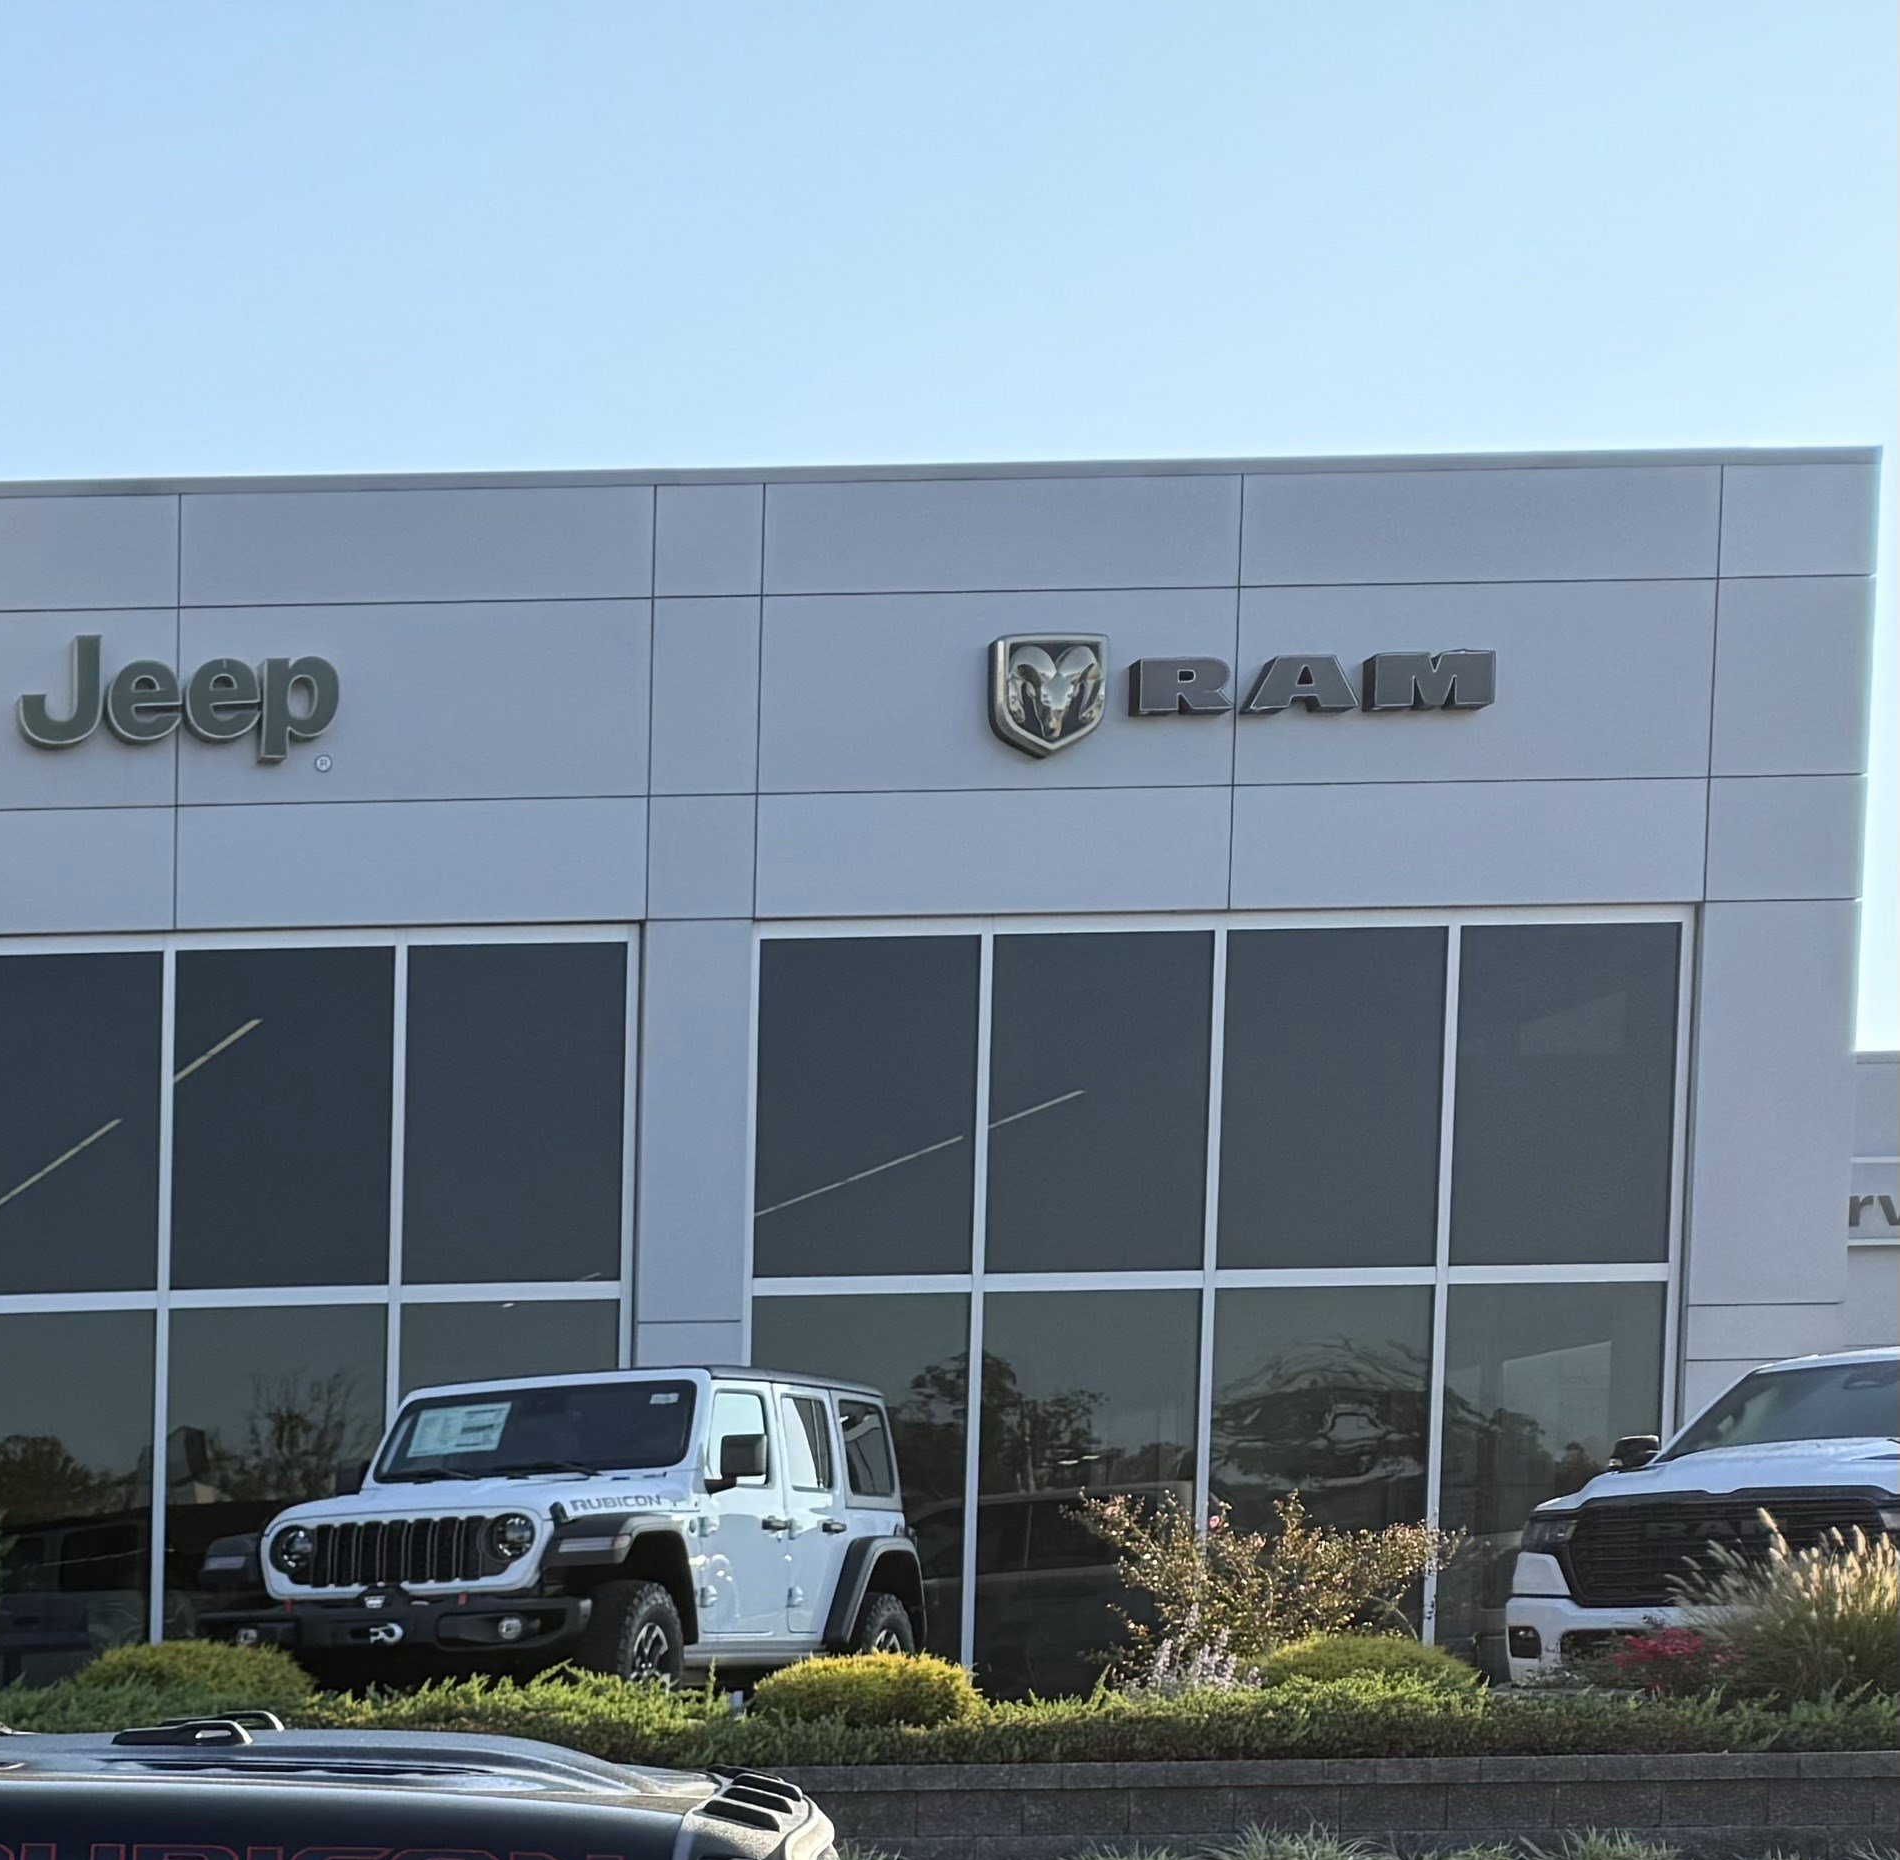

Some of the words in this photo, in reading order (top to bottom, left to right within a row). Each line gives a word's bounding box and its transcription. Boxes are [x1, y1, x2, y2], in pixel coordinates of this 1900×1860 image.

[16, 634, 340, 765] Jeep
[1128, 648, 1497, 717] RAM
[570, 1494, 664, 1512] RUBICON
